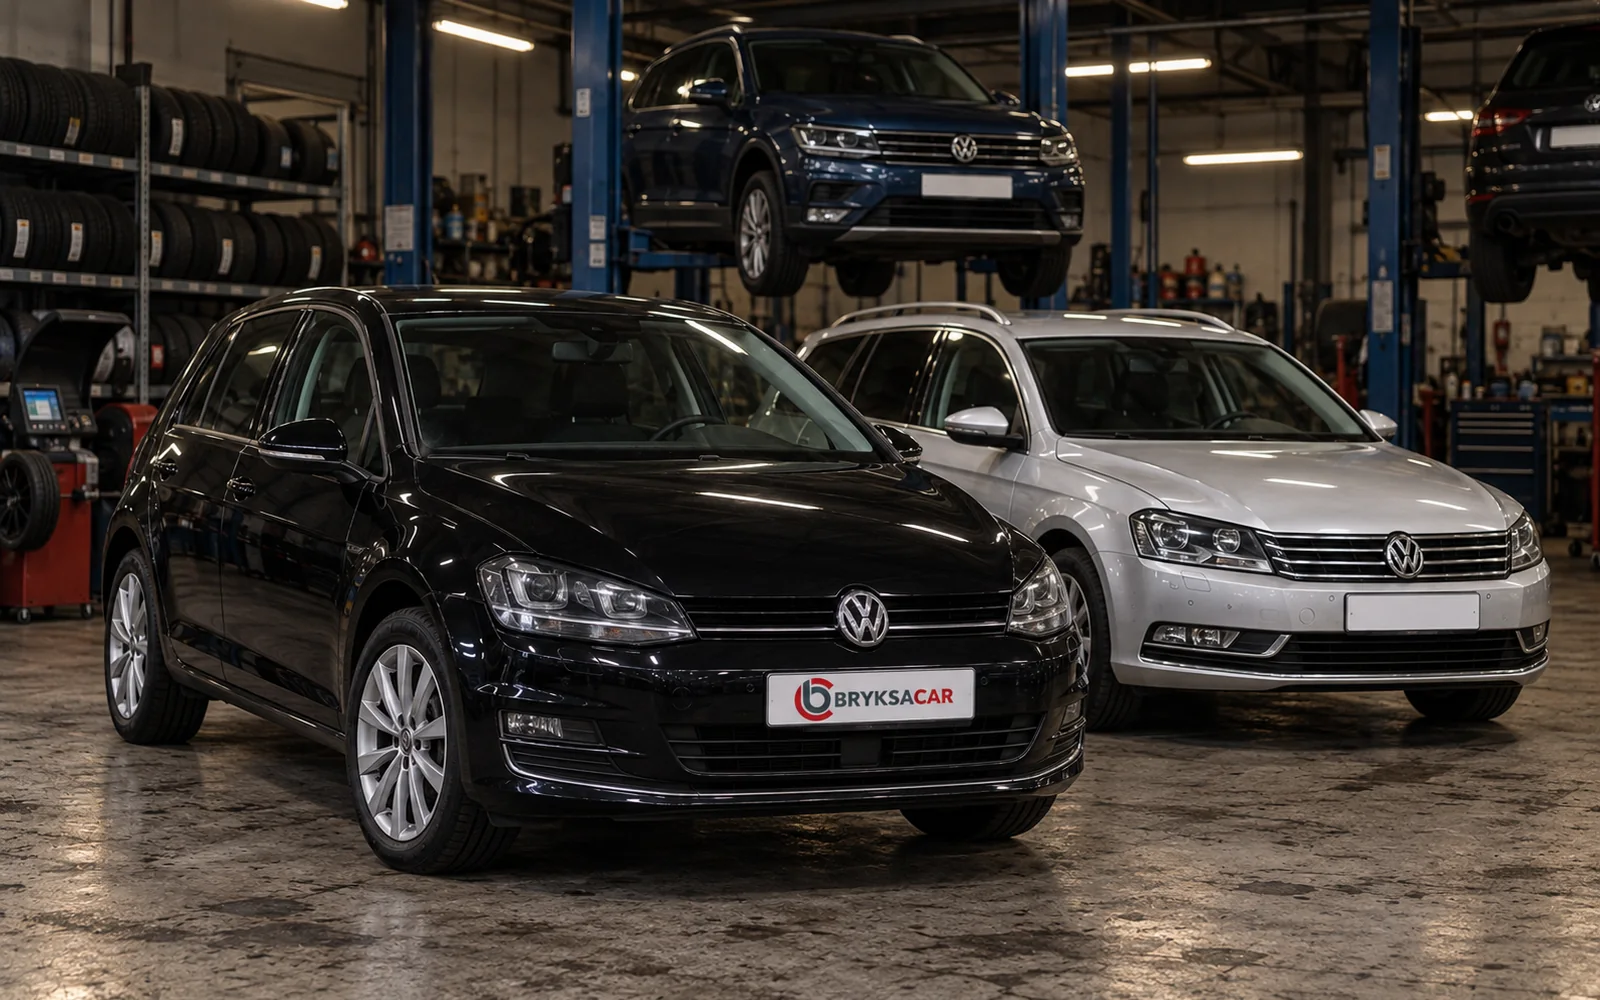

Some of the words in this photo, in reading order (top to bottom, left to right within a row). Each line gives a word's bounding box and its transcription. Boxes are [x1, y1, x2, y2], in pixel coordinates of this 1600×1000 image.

[1387, 535, 1424, 579] VW
[838, 590, 890, 648] VW
[834, 688, 954, 708] BRYKSACAR
